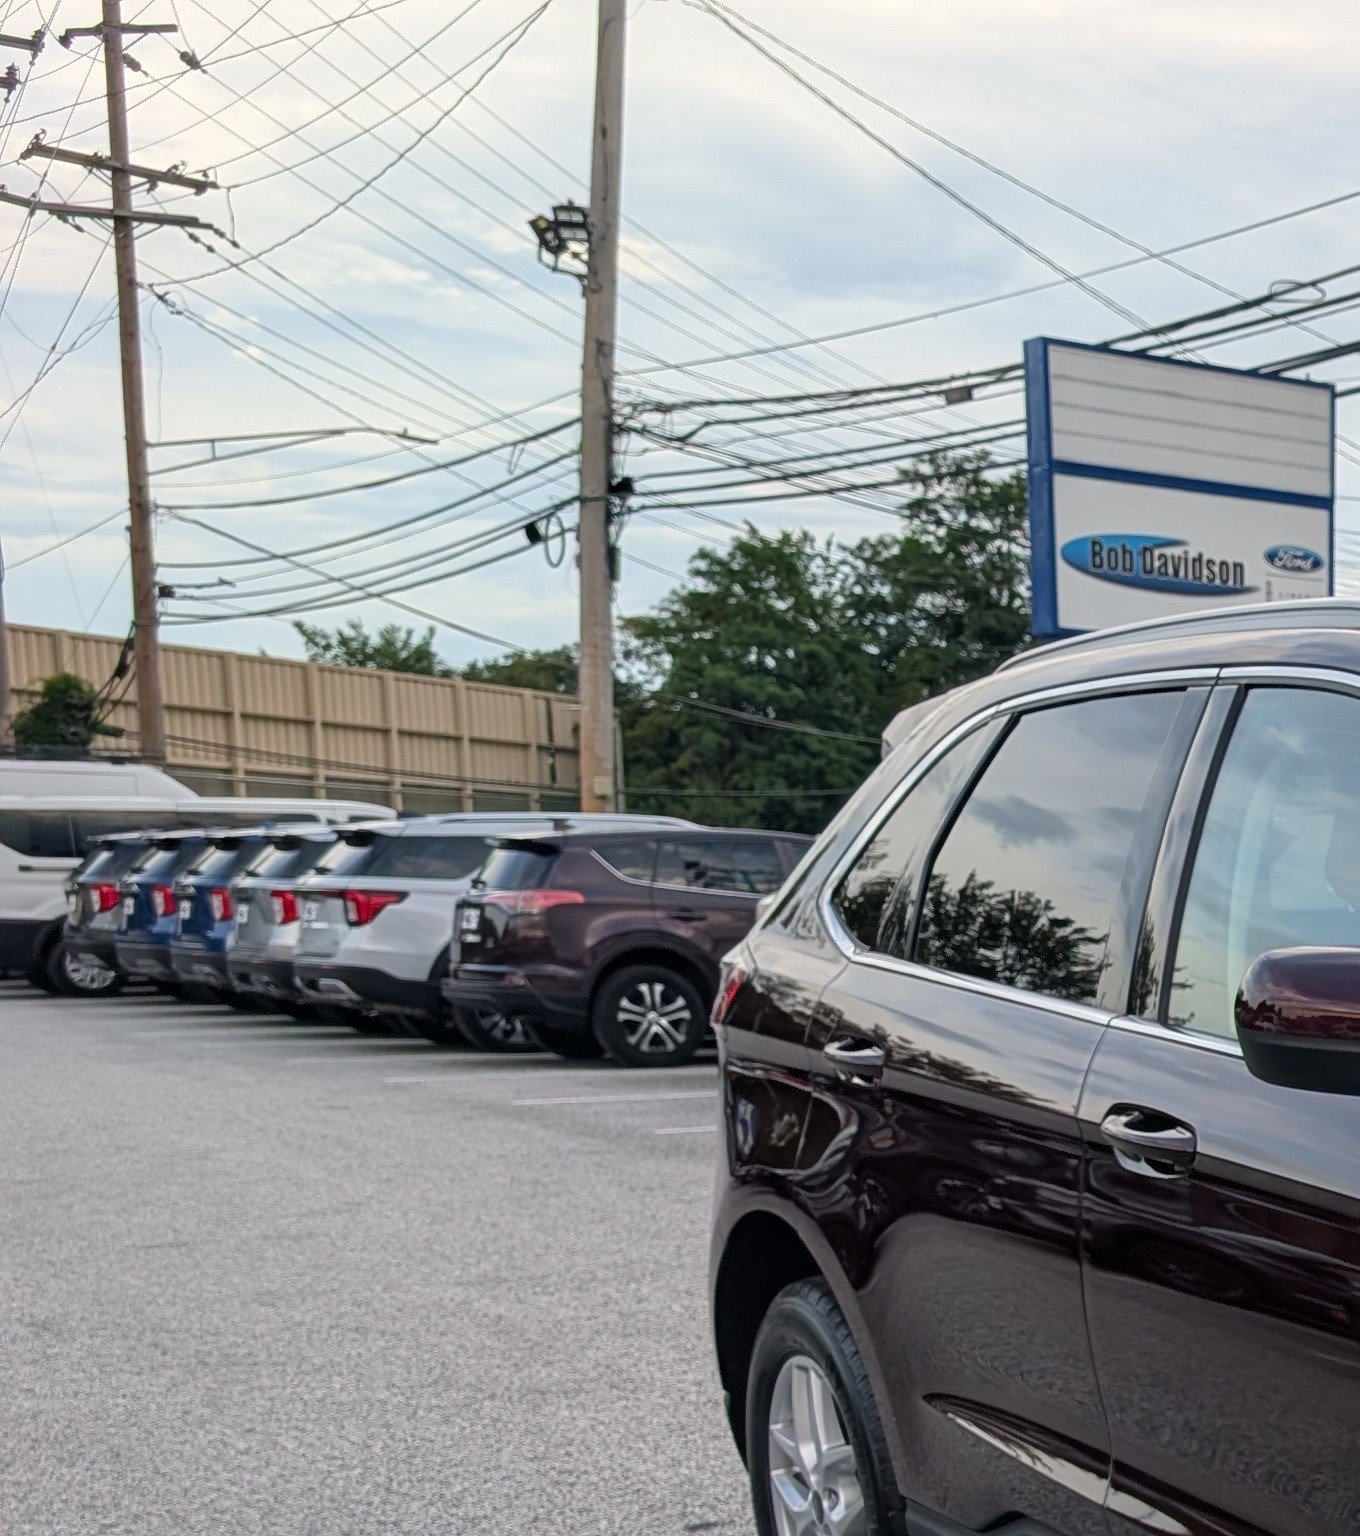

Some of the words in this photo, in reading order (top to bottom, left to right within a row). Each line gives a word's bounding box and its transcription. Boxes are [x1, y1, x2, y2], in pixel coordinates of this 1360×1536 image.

[1090, 539, 1134, 573] Bob
[1142, 544, 1245, 586] Davidson
[1273, 548, 1315, 571] Ford
